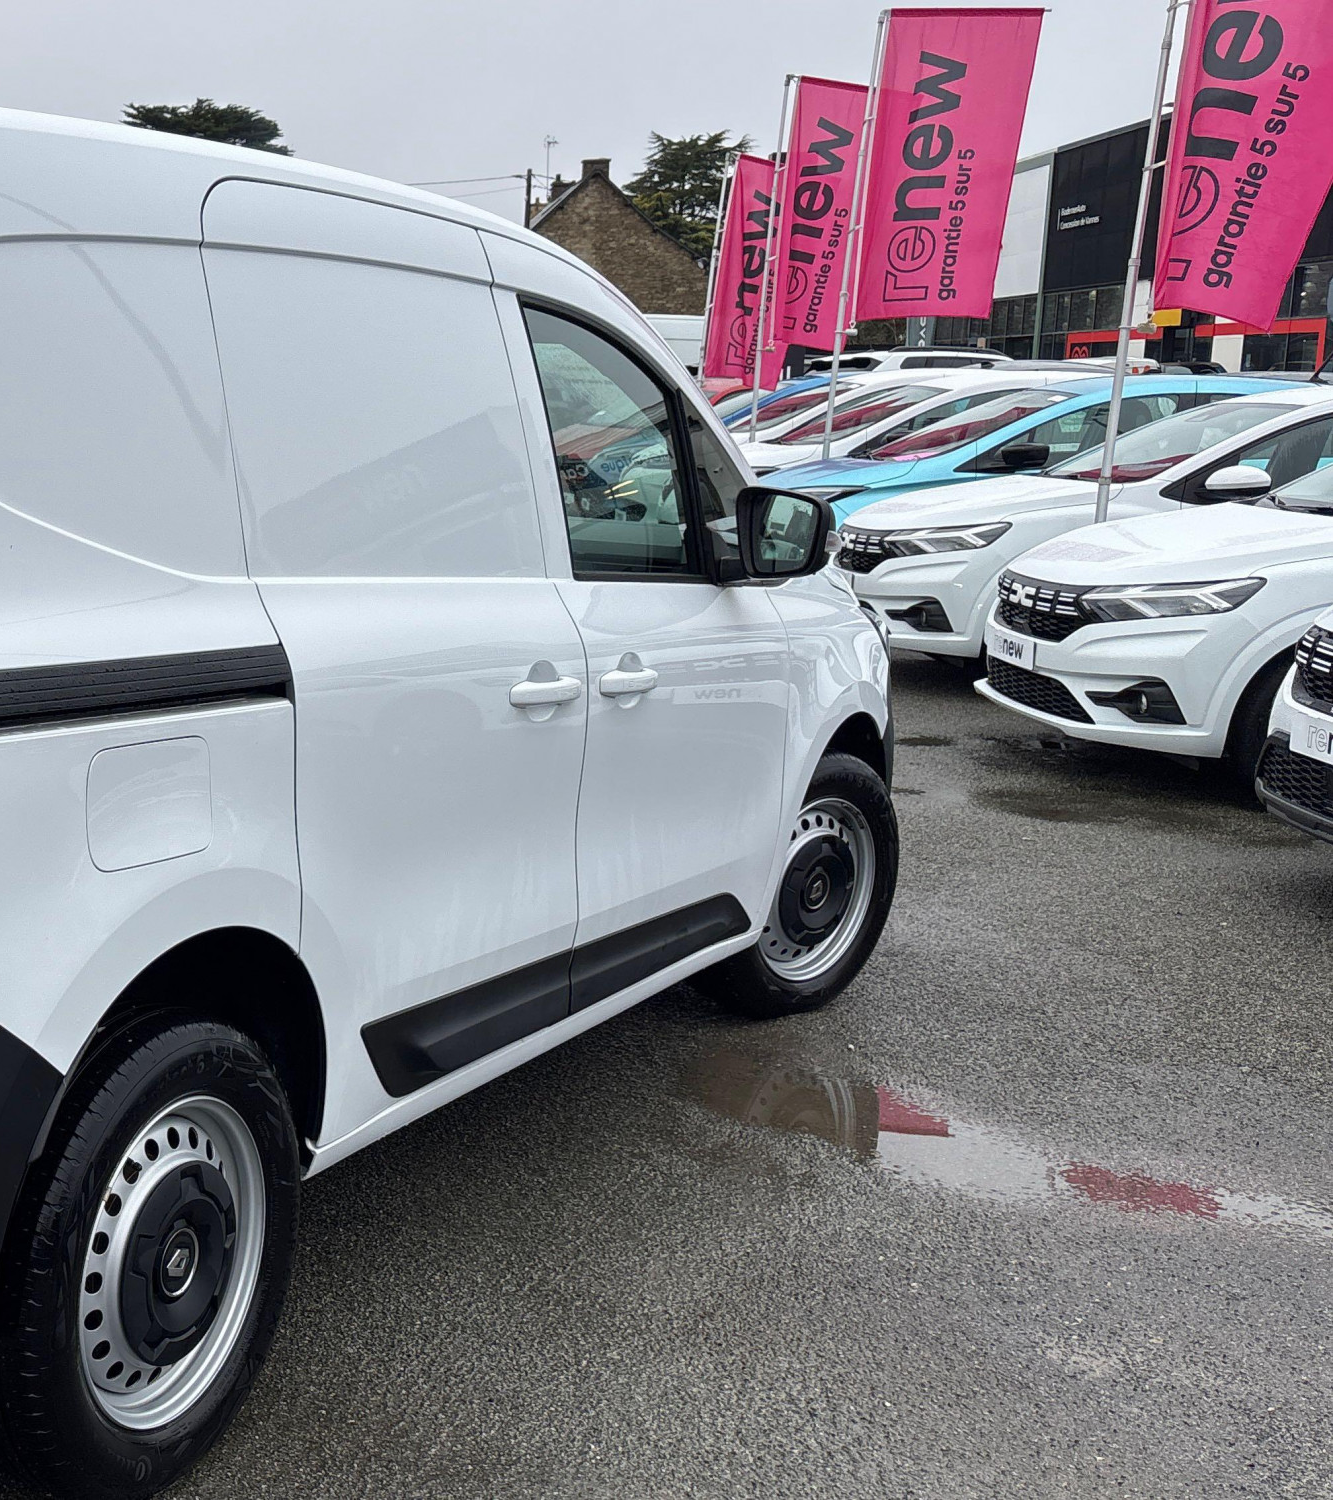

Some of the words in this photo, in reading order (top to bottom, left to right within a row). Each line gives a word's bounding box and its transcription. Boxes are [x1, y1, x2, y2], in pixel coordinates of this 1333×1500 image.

[957, 148, 975, 161] 5
[882, 50, 967, 302] renew
[954, 163, 972, 196] sur
[1202, 161, 1268, 289] garantie
[1249, 137, 1278, 158] 5
[1264, 84, 1300, 136] sur
[1282, 61, 1310, 83] 5
[834, 207, 849, 219] 5
[948, 200, 967, 212] 5
[827, 221, 846, 249] sur
[821, 249, 836, 261] 5
[937, 215, 963, 301] garantie
[725, 189, 781, 367] renew
[803, 263, 831, 334] garantie
